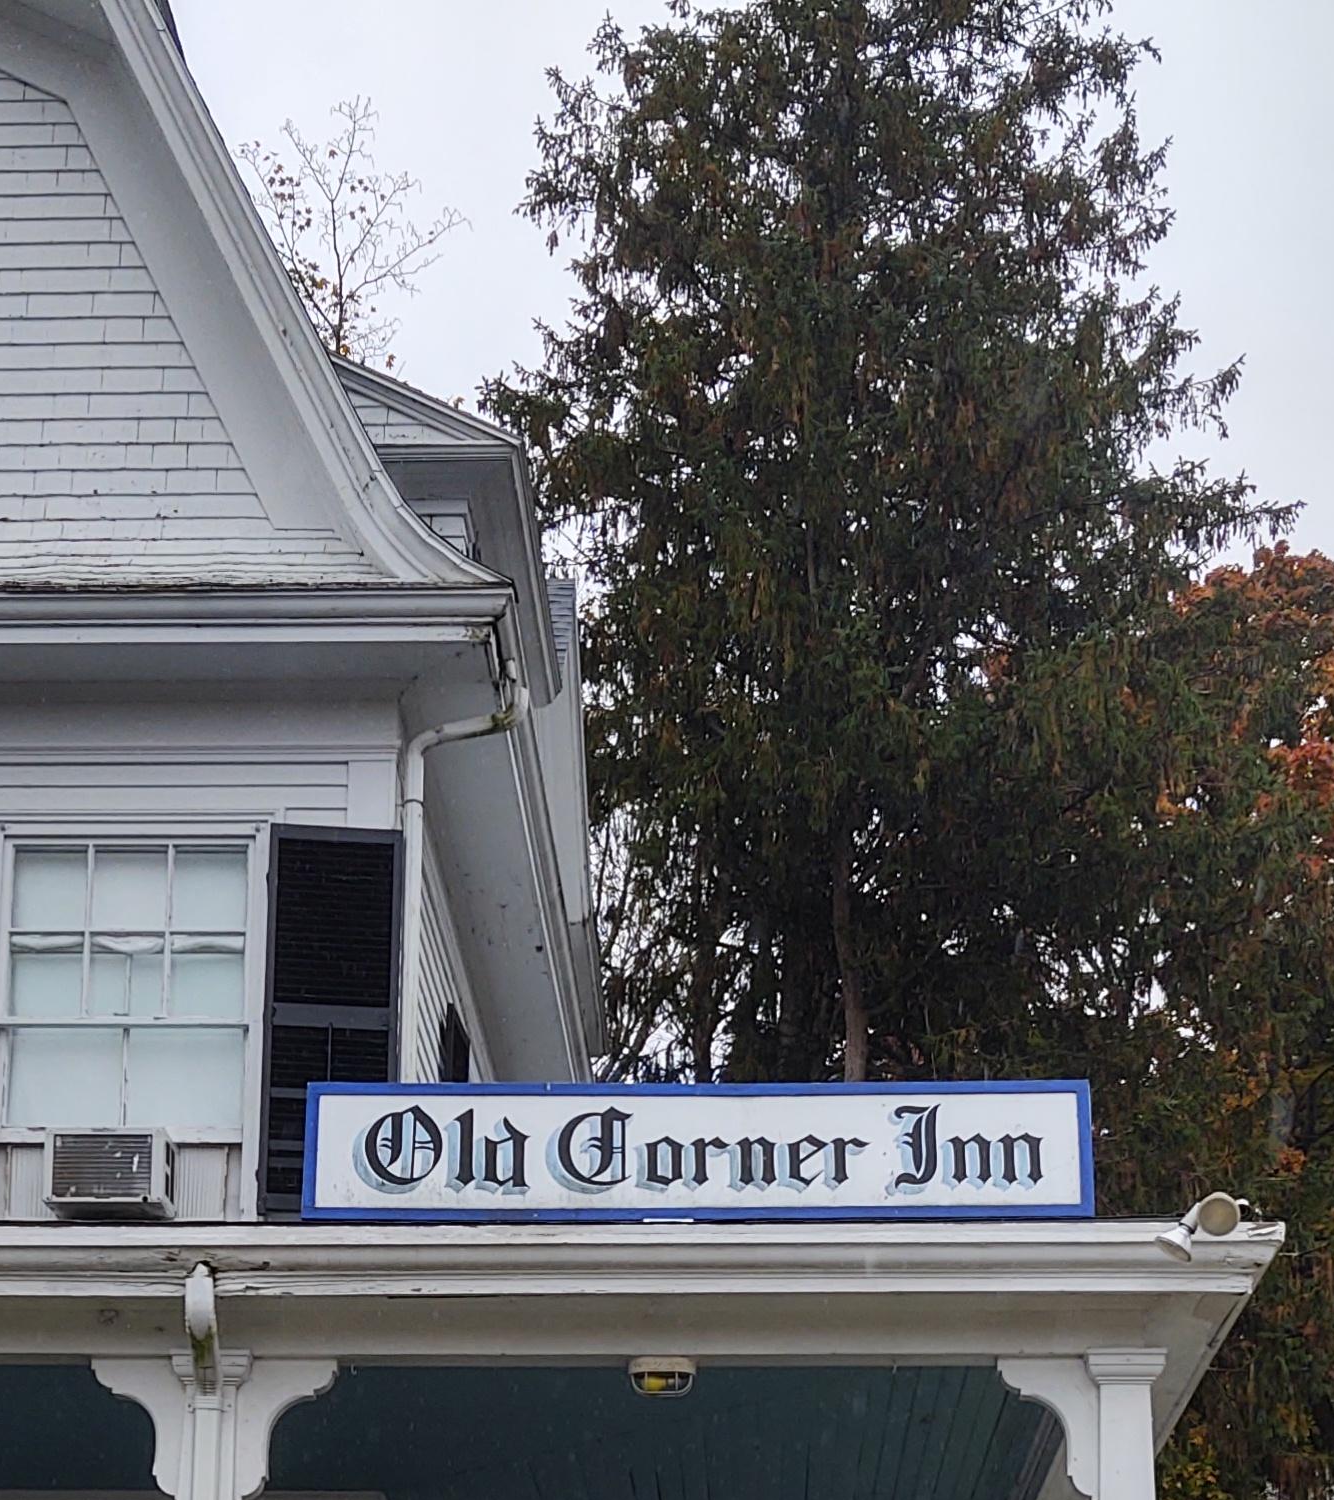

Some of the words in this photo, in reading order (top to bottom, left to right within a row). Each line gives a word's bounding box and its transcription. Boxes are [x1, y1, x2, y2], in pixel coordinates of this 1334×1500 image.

[359, 1104, 531, 1191] Old
[553, 1105, 871, 1189] Corner
[891, 1103, 1045, 1189] Inn
